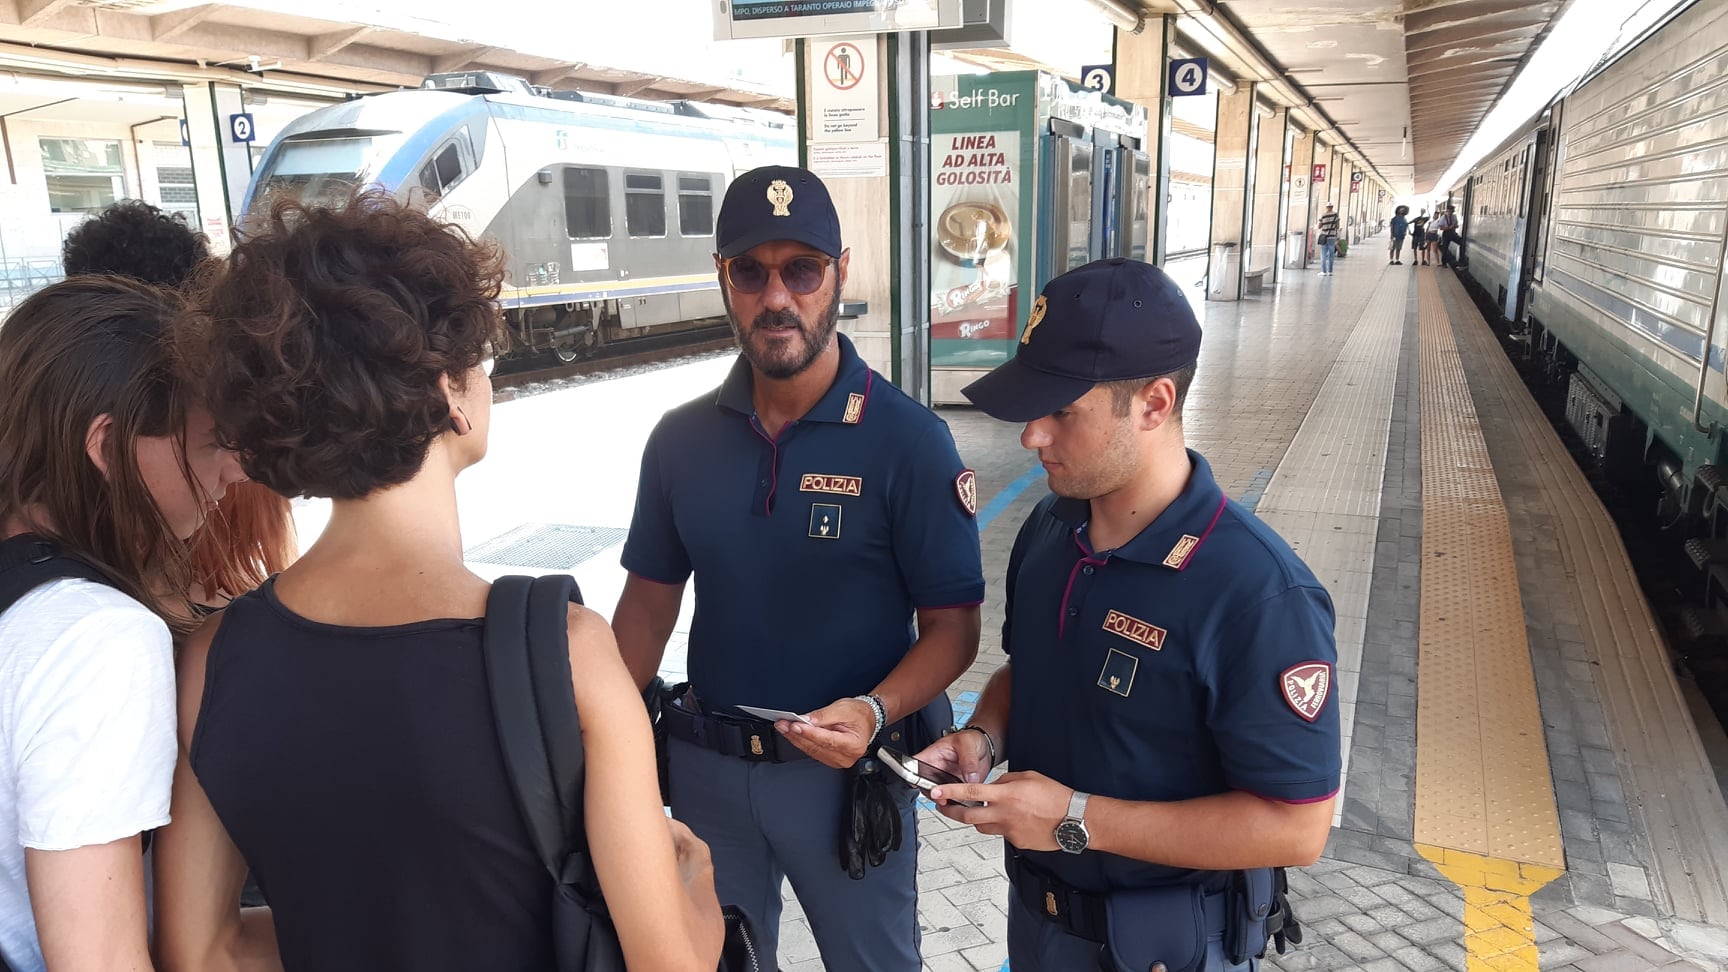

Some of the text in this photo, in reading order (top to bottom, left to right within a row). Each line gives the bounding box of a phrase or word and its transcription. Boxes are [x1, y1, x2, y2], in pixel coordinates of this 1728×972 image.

[752, 6, 783, 14] DISPERSO
[791, 3, 821, 12] TARANTO
[822, 1, 852, 9] OPERAIO
[1091, 74, 1104, 91] 3
[1181, 67, 1196, 87] 4
[949, 89, 1020, 109] Self Bar
[238, 120, 247, 135] 2
[951, 135, 996, 150] LINEA
[943, 152, 1005, 168] AD ALTA
[936, 167, 1012, 186] GOLOSITÀ
[803, 476, 858, 493] POLIZIA
[1105, 613, 1159, 647] POLIZIA
[1287, 680, 1308, 711] POLIZIA
